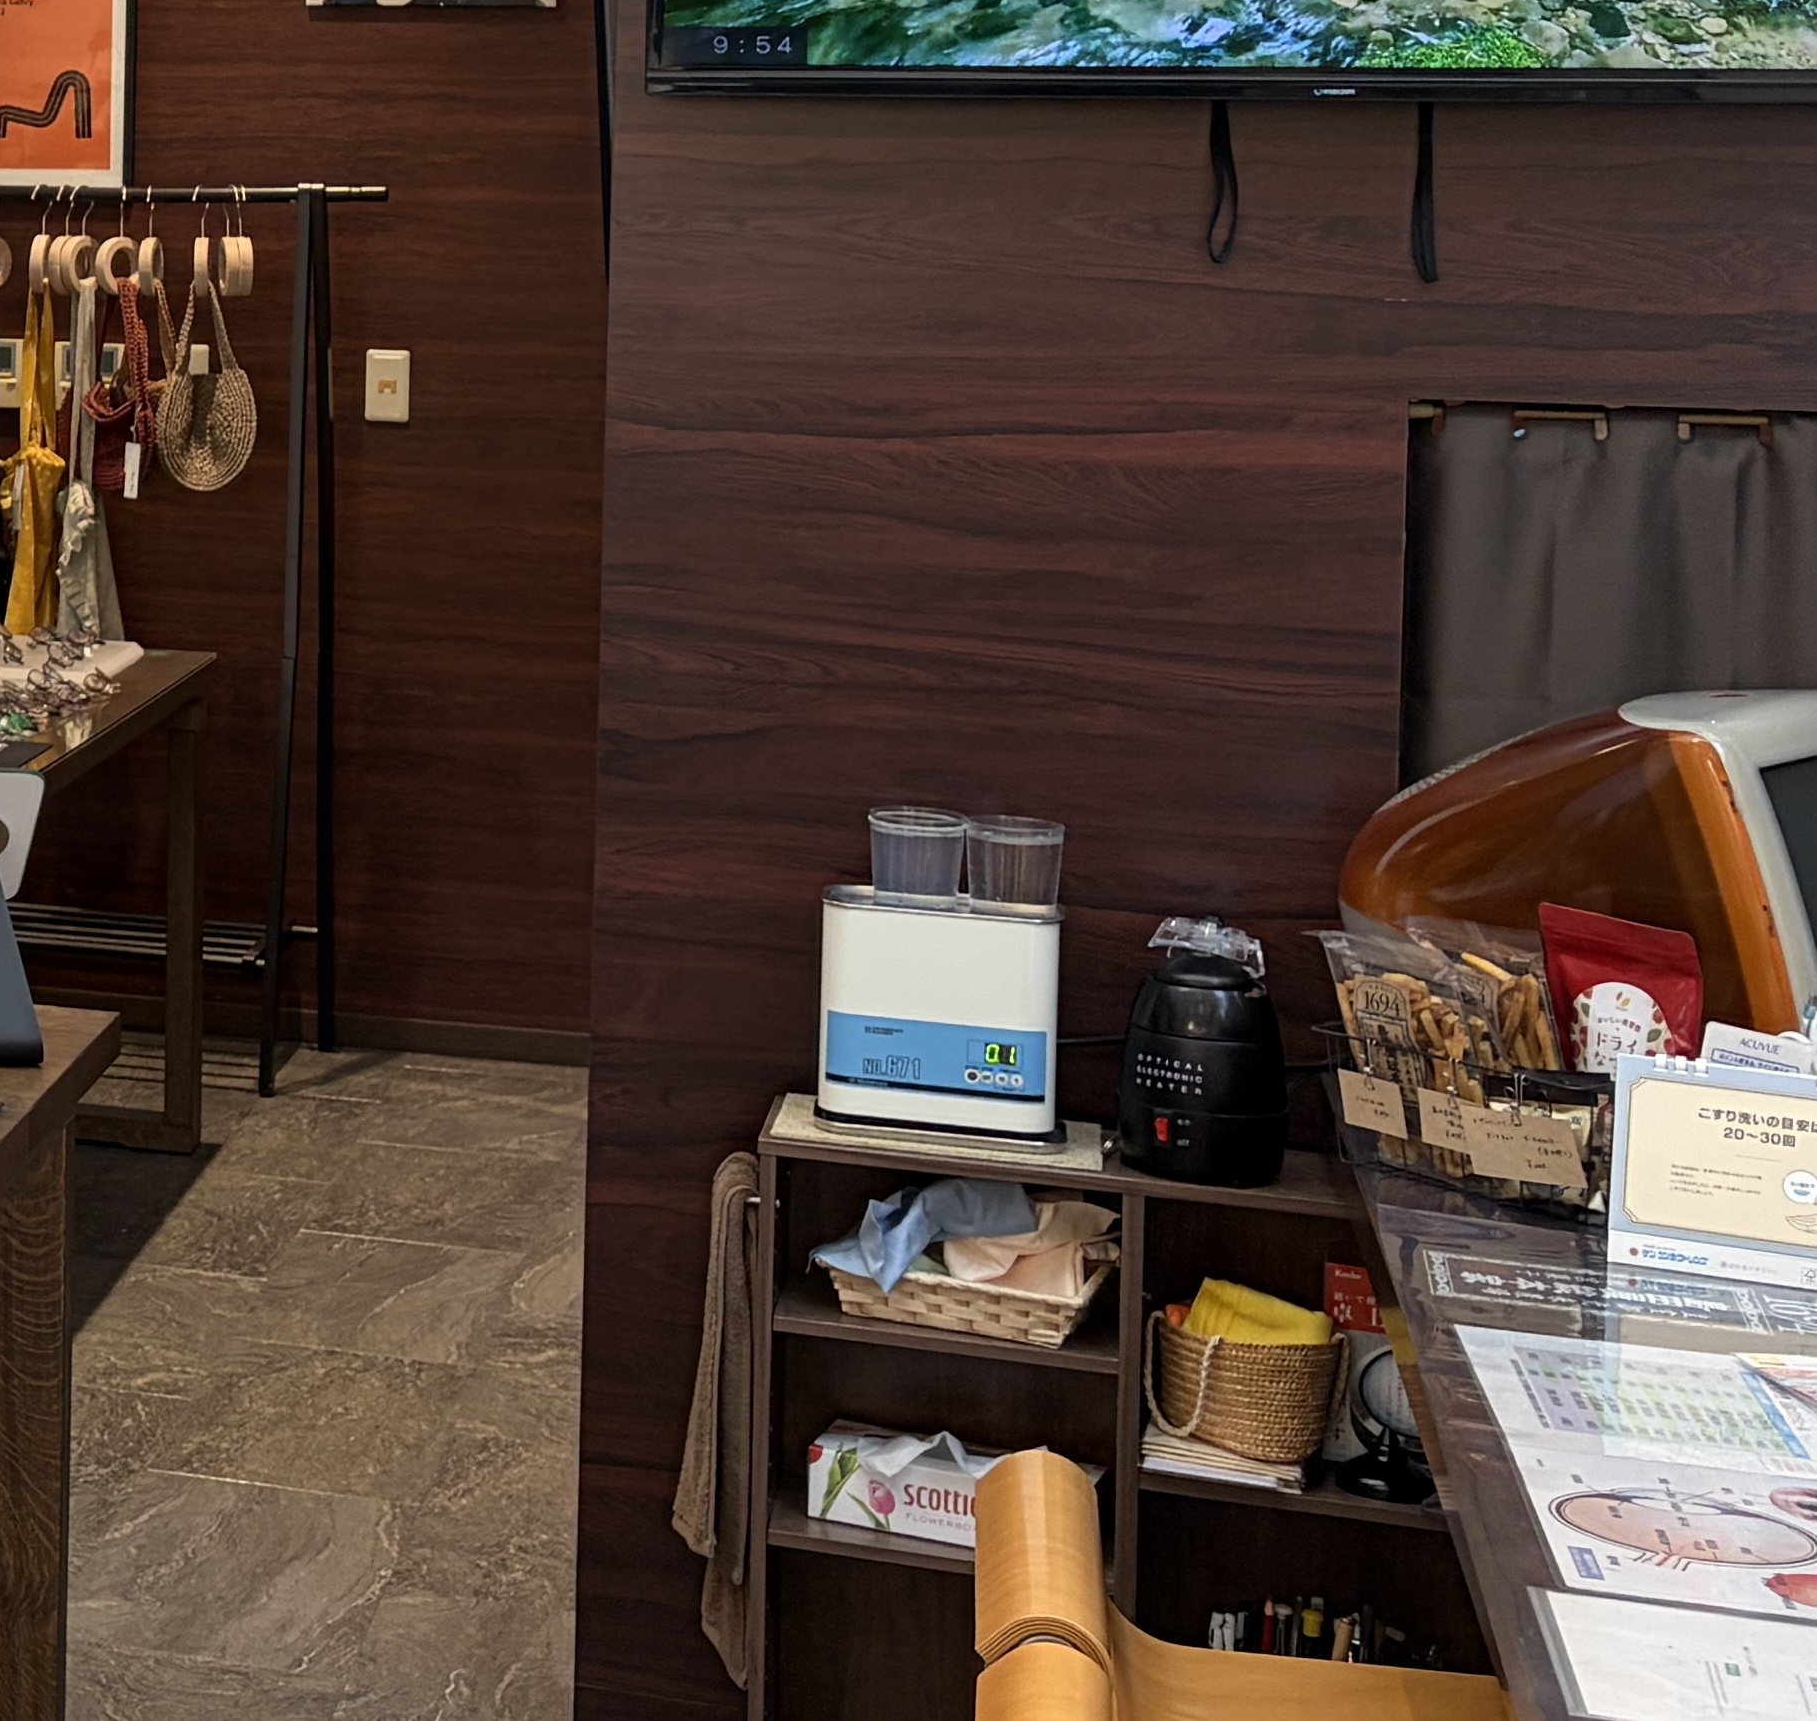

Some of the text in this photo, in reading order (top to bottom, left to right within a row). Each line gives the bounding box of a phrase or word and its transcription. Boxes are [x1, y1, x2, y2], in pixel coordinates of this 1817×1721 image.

[712, 35, 793, 55] 9:54
[1363, 989, 1401, 1018] 1694
[1596, 1030, 1638, 1055] ドライ
[1738, 1037, 1783, 1056] ACUVUE
[1137, 1052, 1203, 1072] OPTICAL
[1136, 1064, 1203, 1084] ELECTRONIC
[1135, 1077, 1202, 1096] HEATER
[905, 1512, 976, 1532] FLOWERBO
